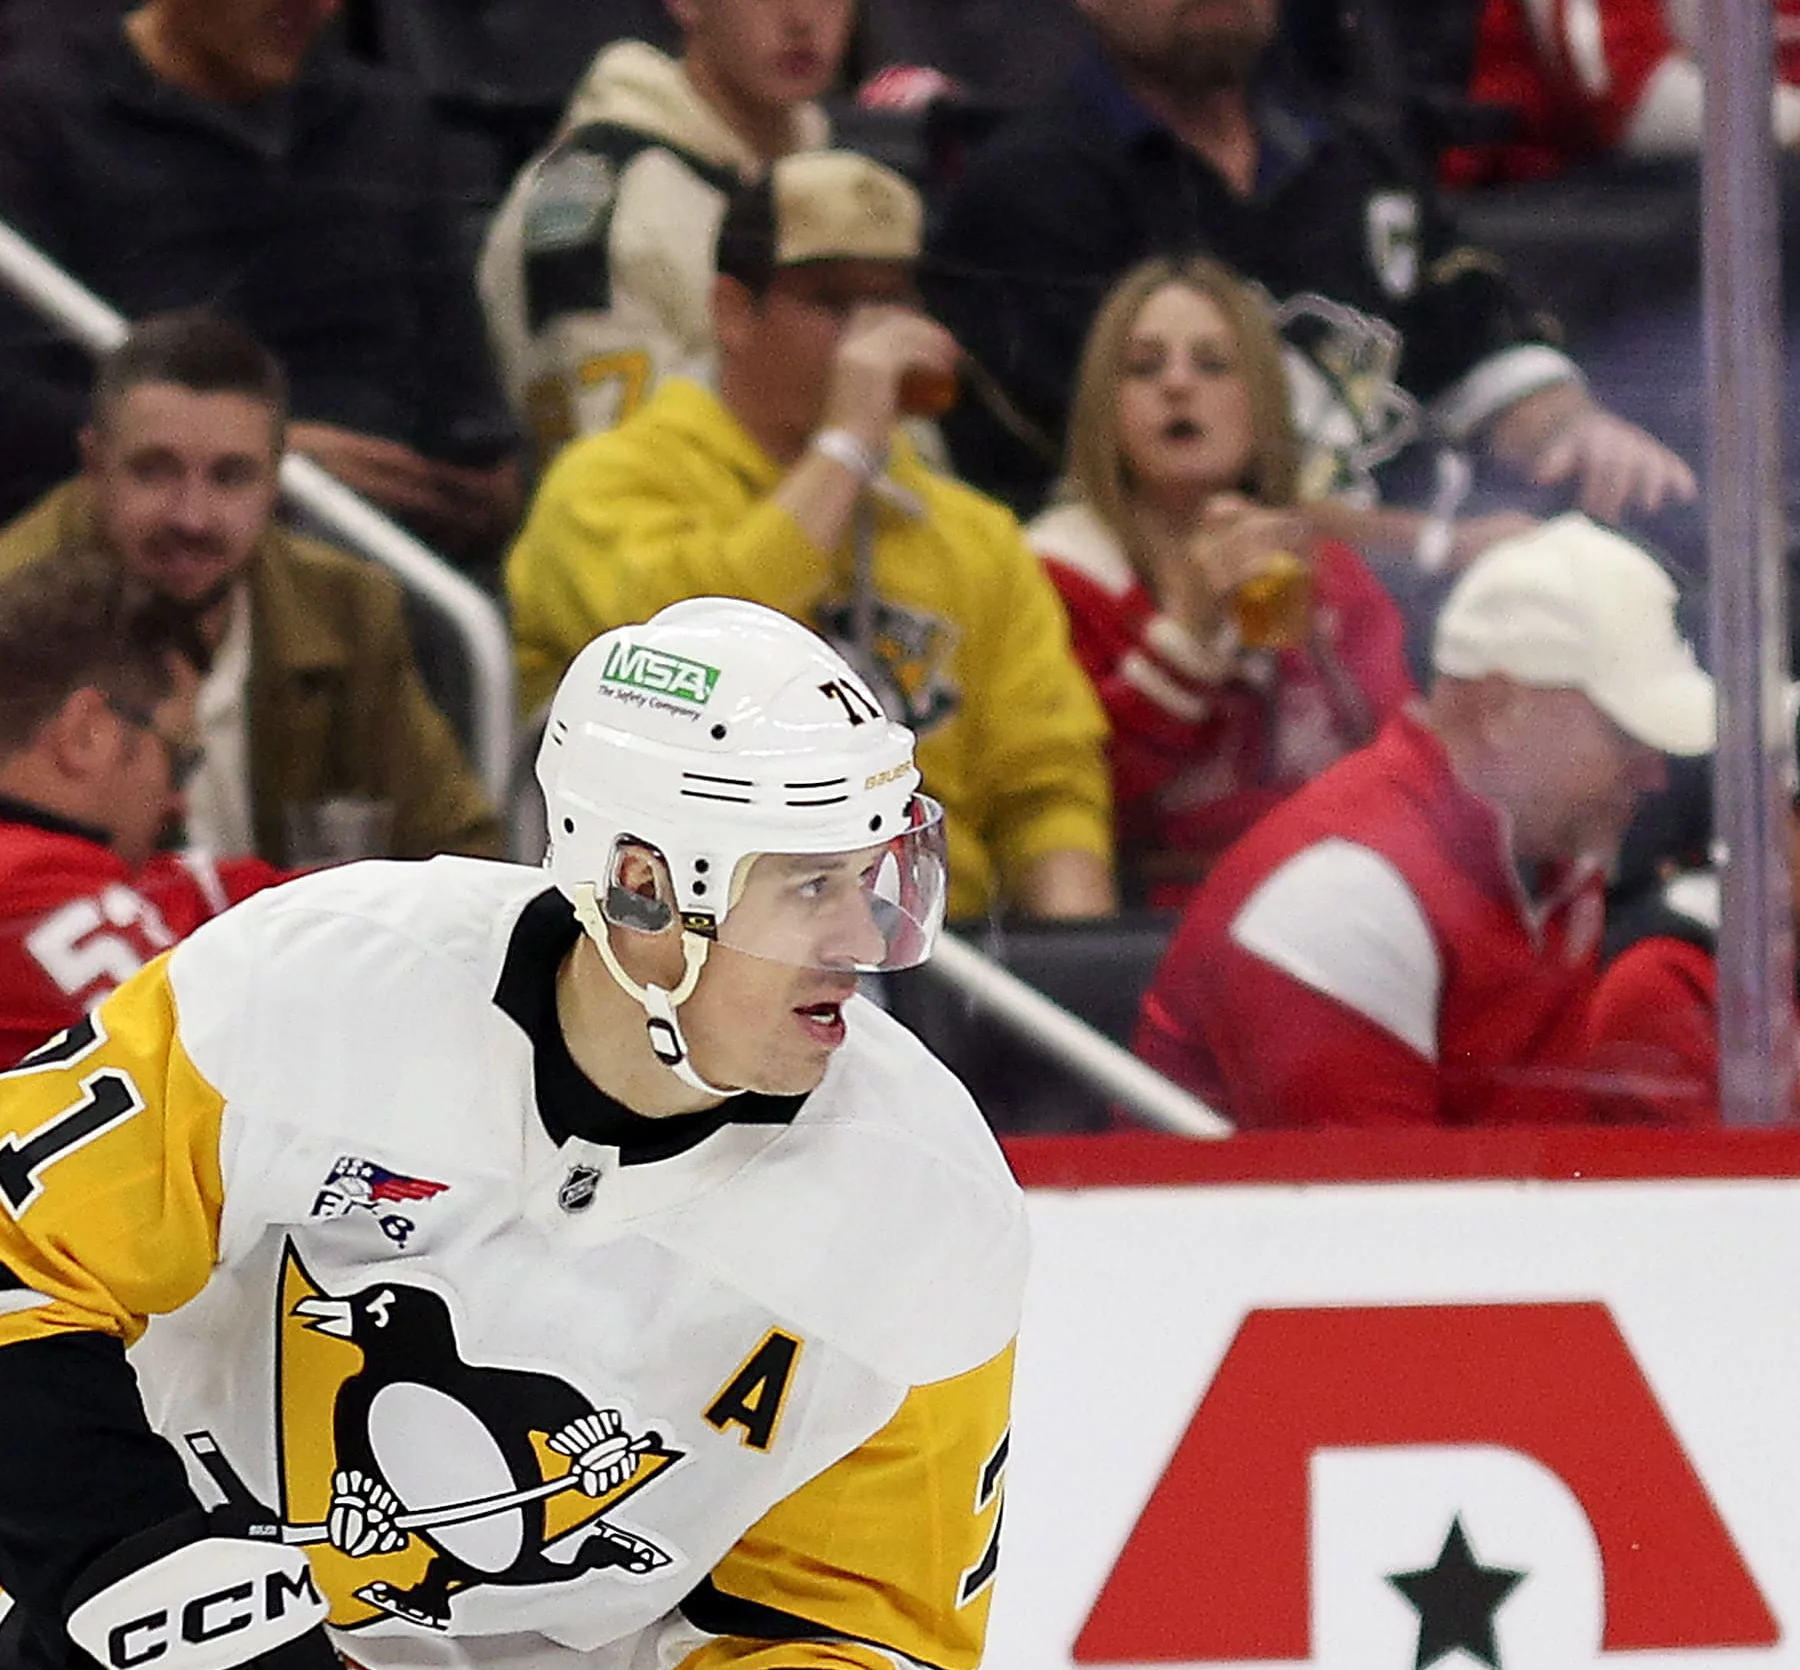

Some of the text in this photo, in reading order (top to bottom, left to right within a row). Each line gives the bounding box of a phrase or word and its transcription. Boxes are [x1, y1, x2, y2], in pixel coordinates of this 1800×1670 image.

[605, 640, 710, 702] MSA
[816, 677, 882, 727] 71
[615, 689, 648, 709] Safety
[648, 697, 702, 722] Company
[702, 1326, 804, 1454] A
[109, 1563, 322, 1670] CCM
